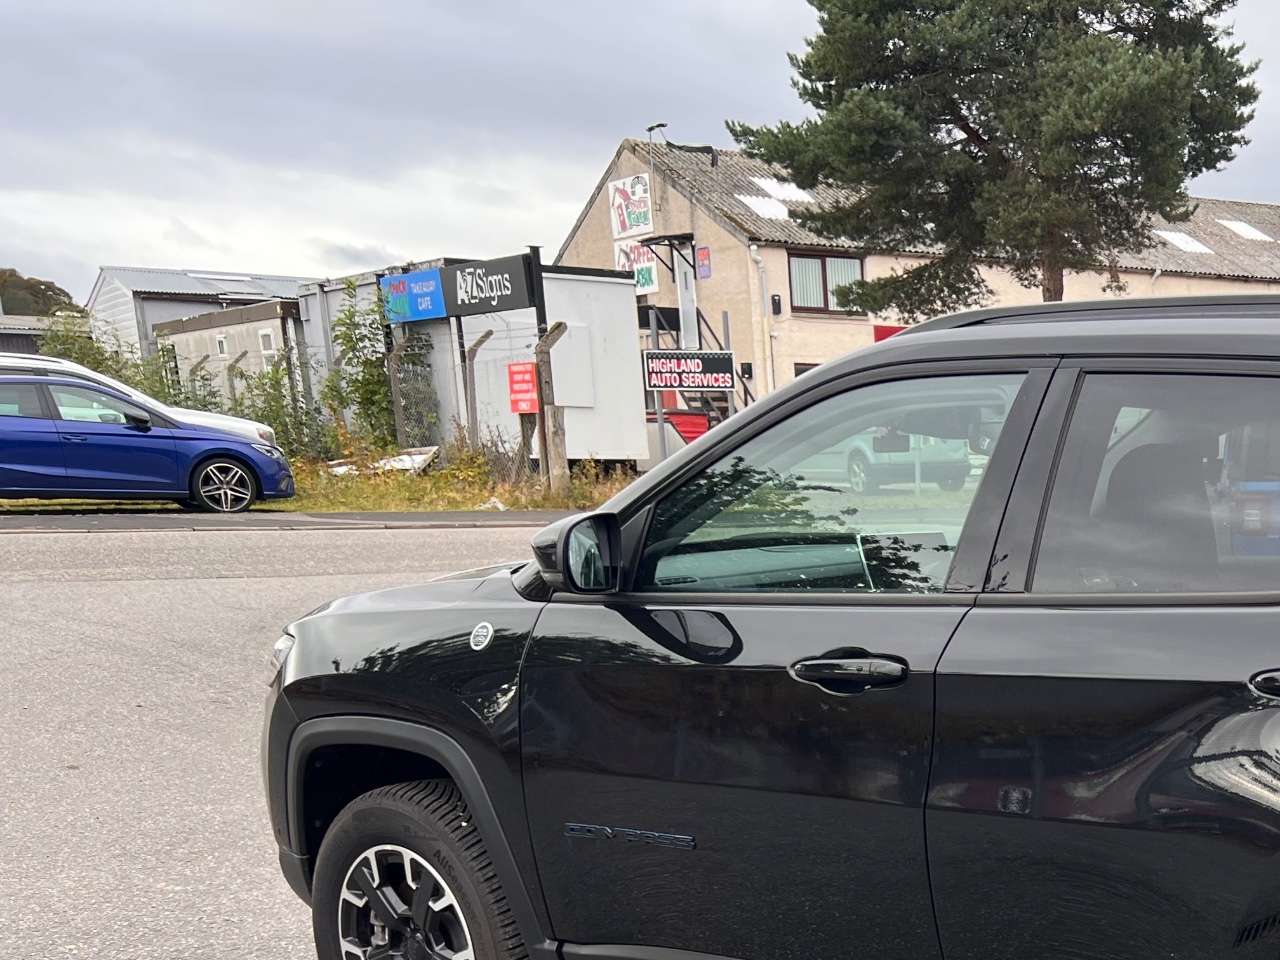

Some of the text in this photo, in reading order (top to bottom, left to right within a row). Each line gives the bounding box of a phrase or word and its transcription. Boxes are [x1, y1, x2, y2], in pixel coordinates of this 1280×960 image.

[648, 358, 703, 373] HIGHLAND
[650, 373, 732, 387] AUTO SERVICES
